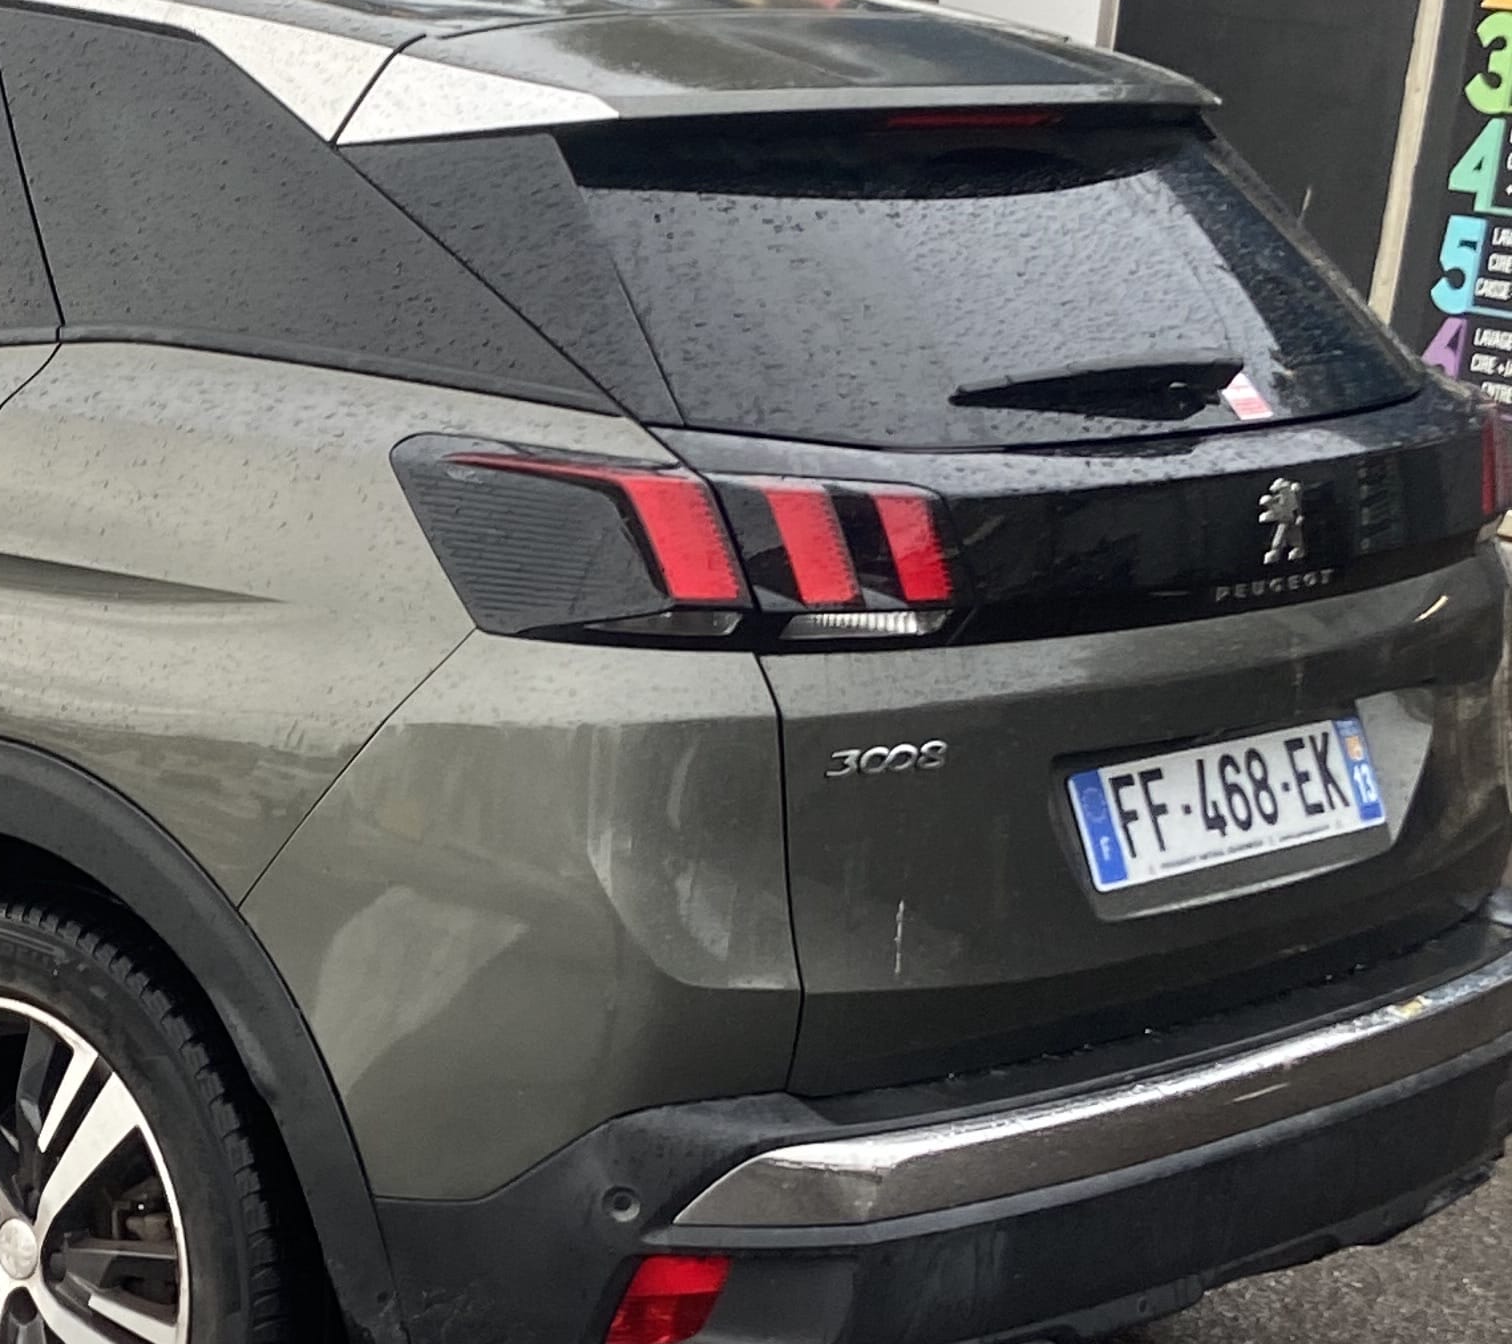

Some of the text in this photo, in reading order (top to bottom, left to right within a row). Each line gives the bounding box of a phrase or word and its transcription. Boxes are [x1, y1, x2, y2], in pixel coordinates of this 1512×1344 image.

[1464, 11, 1512, 114] 3
[1448, 117, 1506, 212] 4
[1430, 215, 1487, 314] 5
[1215, 568, 1334, 602] PEUGEOT
[826, 739, 947, 777] 3008
[1108, 731, 1350, 858] FF-468-EK
[1353, 763, 1376, 804] 13
